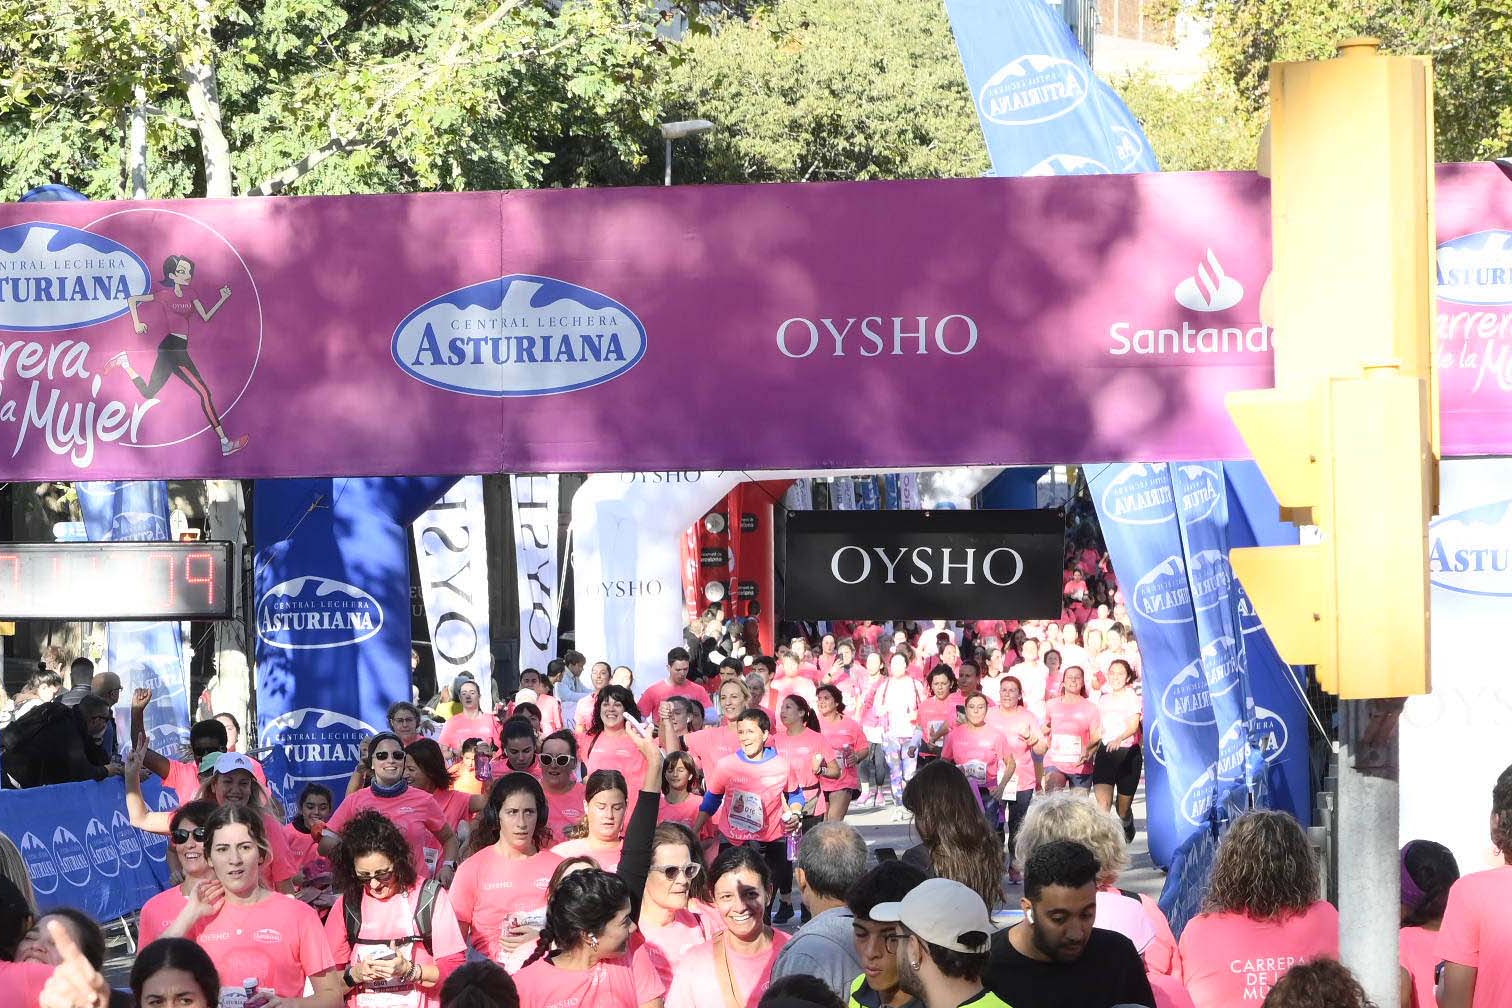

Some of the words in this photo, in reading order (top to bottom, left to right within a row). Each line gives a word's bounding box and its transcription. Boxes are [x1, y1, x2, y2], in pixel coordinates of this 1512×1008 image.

[54, 257, 126, 270] LECHERA
[450, 317, 530, 331] CENTRAL
[538, 315, 620, 329] LECHERA
[776, 314, 979, 359] OYSHO
[411, 322, 628, 367] ASTURIANA
[11, 370, 161, 469] Mujer
[831, 546, 1024, 588] OYSHO
[261, 606, 375, 632] ASTURIANA
[274, 601, 315, 610] CENTRAL
[321, 600, 369, 609] LECHERA
